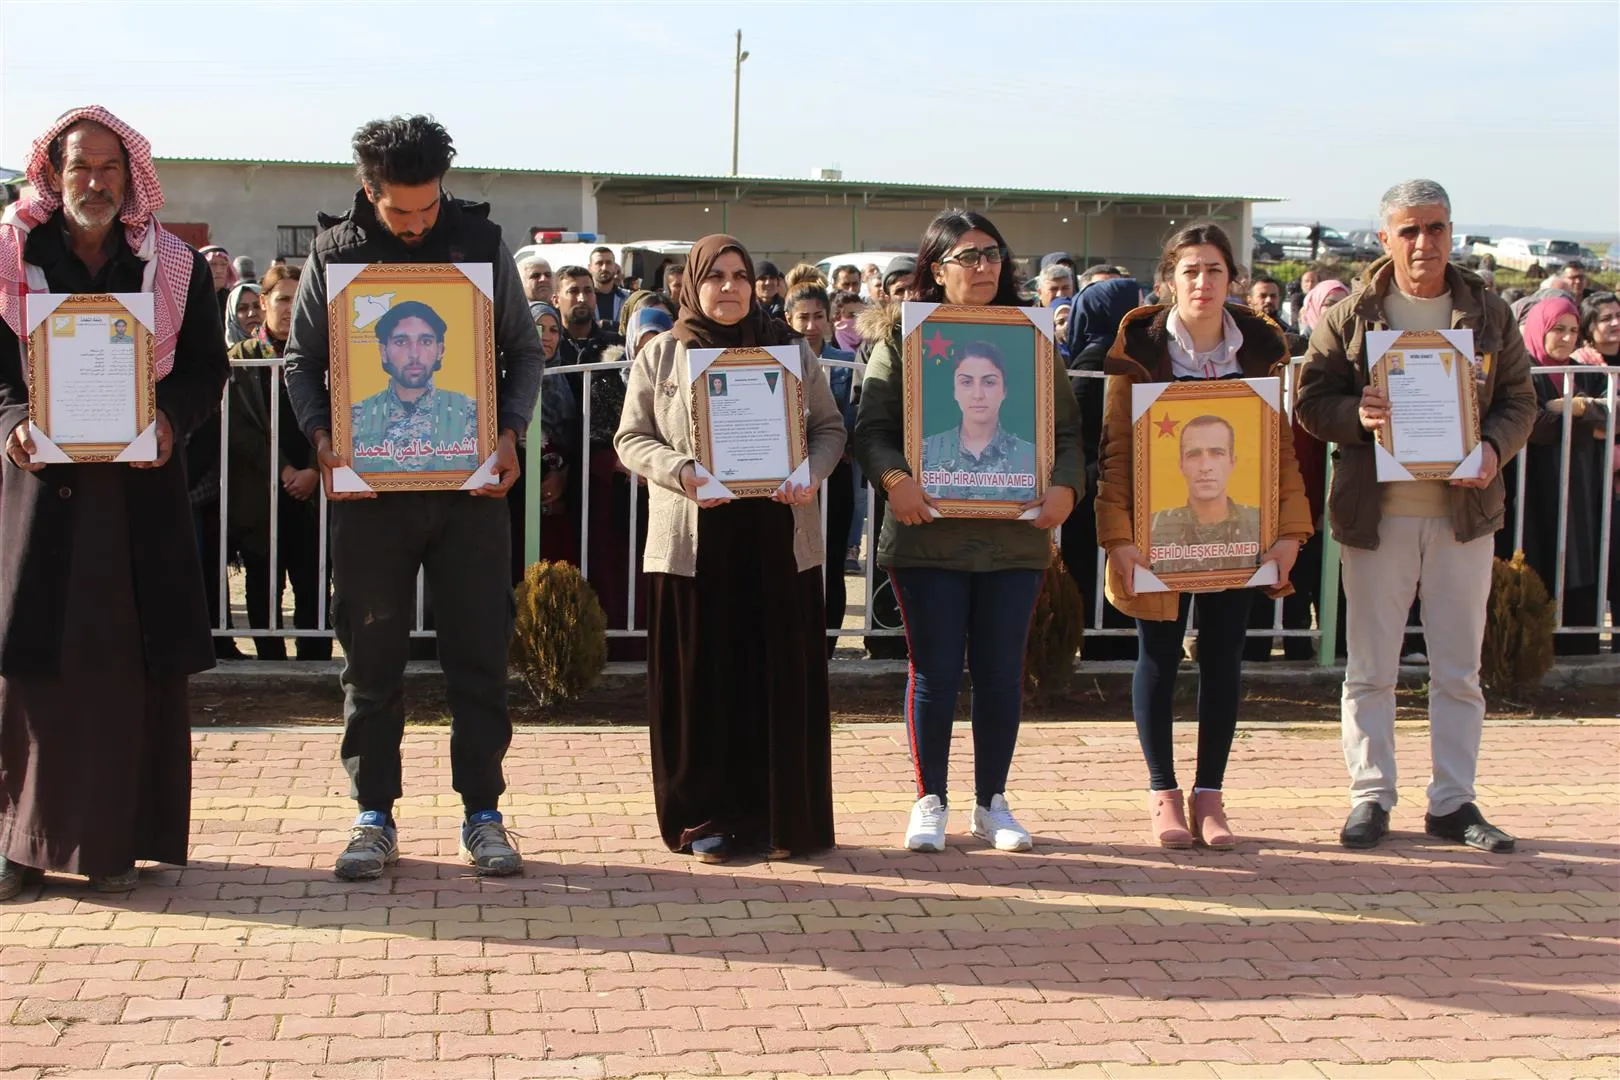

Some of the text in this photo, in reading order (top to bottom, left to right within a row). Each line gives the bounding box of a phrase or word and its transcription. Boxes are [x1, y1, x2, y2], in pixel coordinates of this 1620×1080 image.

[355, 439, 393, 458] المحمد
[977, 472, 1005, 487] VIYAN
[1006, 473, 1035, 488] AMED
[1183, 544, 1226, 562] LEŞKER
[1227, 542, 1259, 557] AMED
